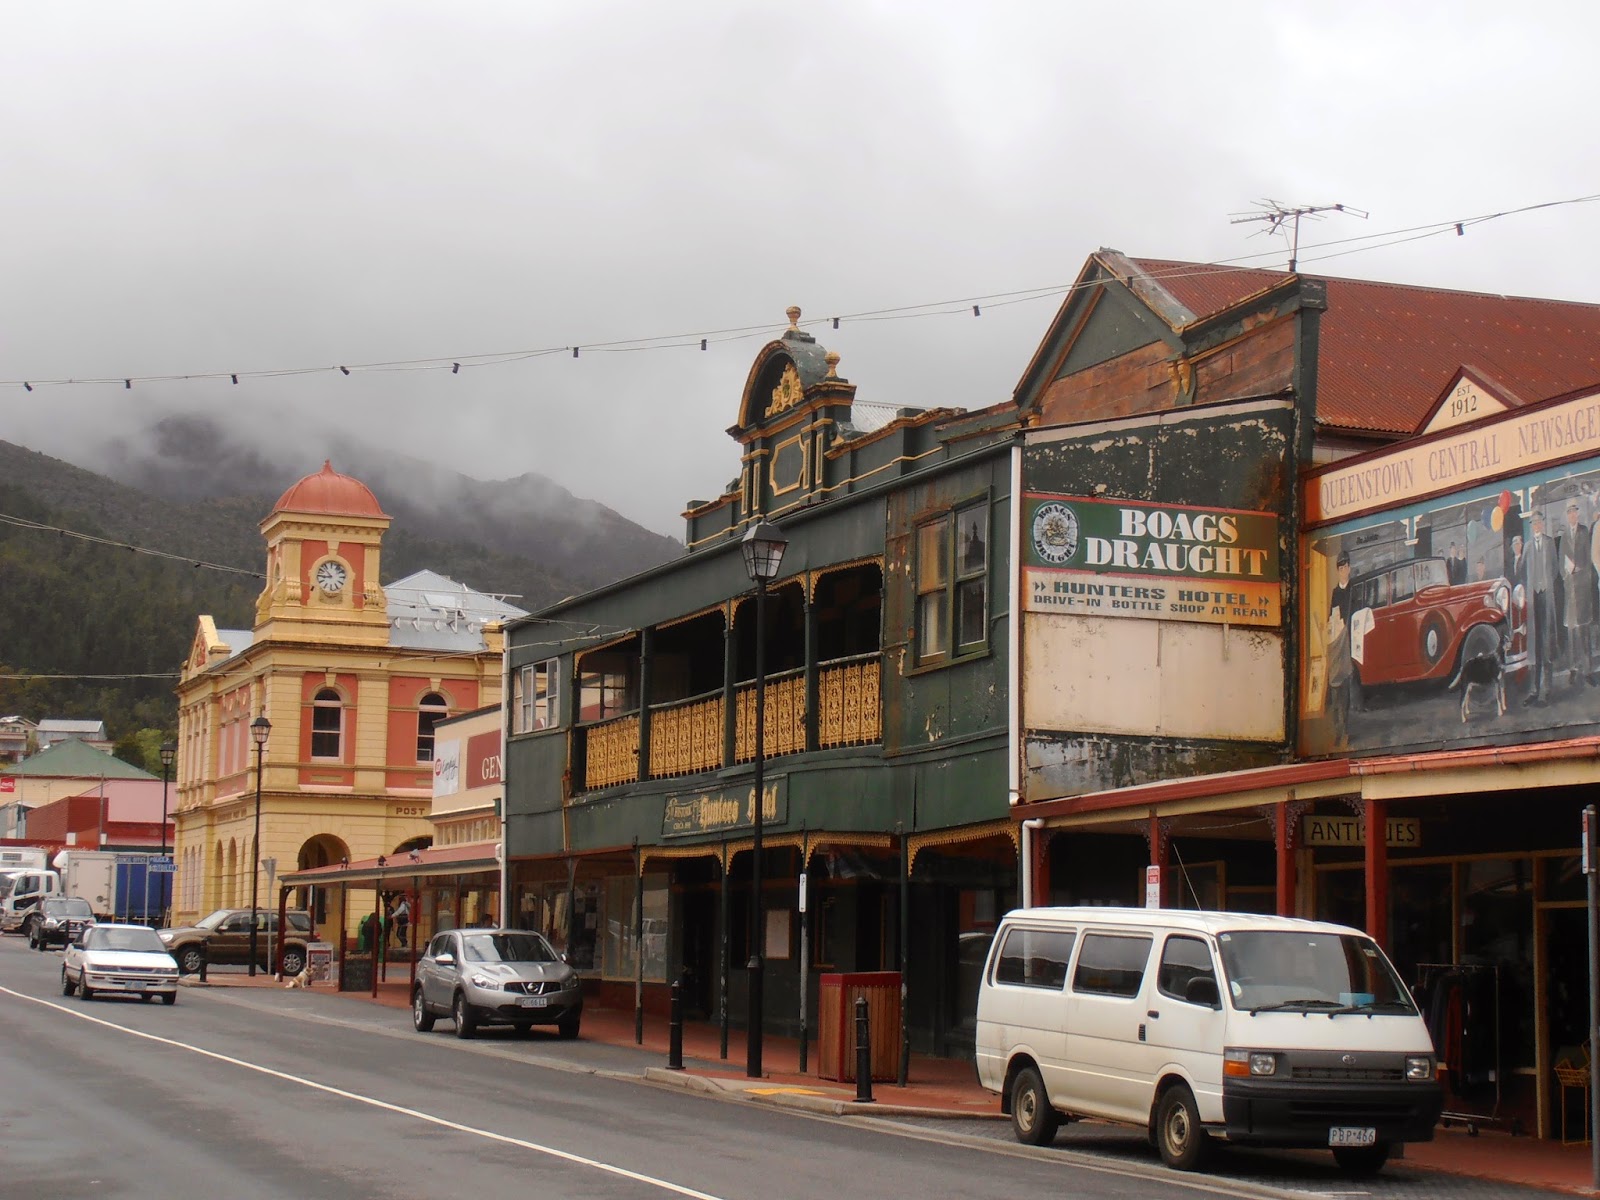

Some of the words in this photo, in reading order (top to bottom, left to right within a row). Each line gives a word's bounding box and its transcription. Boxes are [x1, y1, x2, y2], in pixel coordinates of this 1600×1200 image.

[1456, 384, 1472, 397] EST
[1450, 395, 1477, 418] 1912
[1319, 457, 1414, 514] QUEENSTOWN
[1428, 434, 1500, 482] CENTRAL
[1119, 508, 1238, 543] BOAGS
[1085, 537, 1268, 576] DRAUGHT
[1034, 594, 1101, 607] DRIVE-IN
[1112, 600, 1162, 611] BOTTLE
[1170, 603, 1205, 614] SHOP
[1211, 606, 1226, 615] AT
[1232, 607, 1268, 617] REAR
[1053, 581, 1166, 600] HUNTERS
[1178, 589, 1250, 606] HOTEL
[396, 807, 425, 815] POST
[746, 782, 778, 825] Htel
[1311, 822, 1415, 841] ANTIUES
